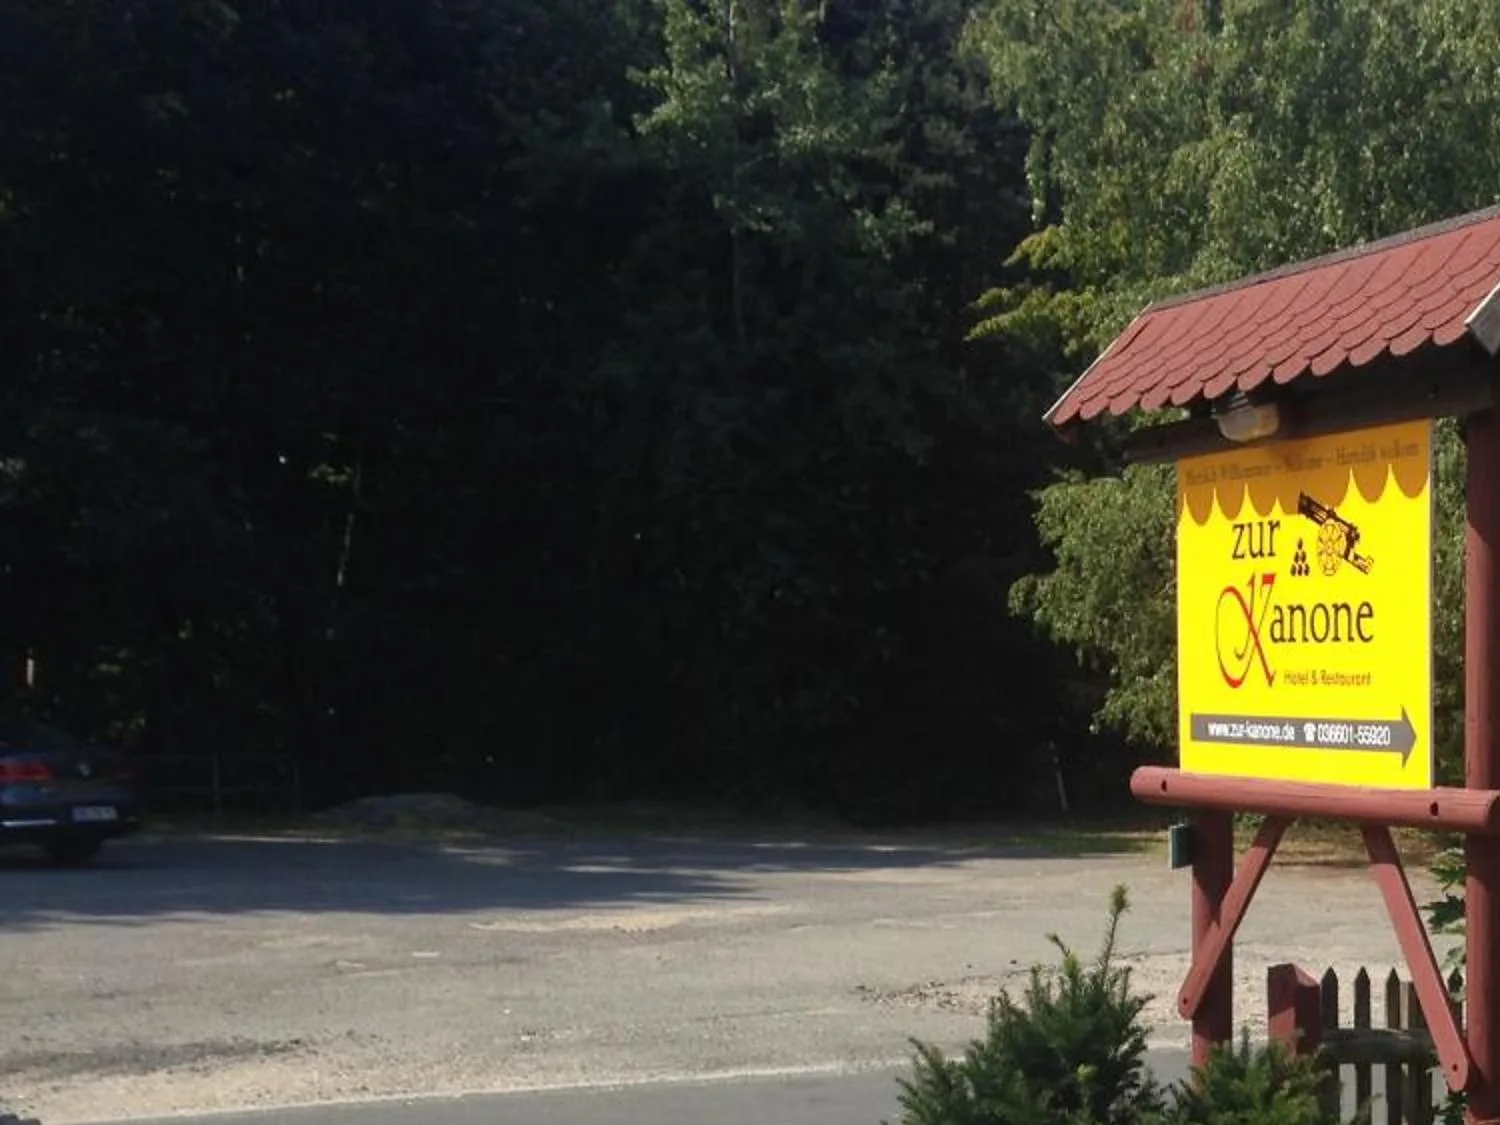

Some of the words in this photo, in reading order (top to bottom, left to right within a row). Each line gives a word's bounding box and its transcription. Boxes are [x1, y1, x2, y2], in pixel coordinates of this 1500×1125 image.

[1231, 519, 1281, 560] zur
[1215, 572, 1375, 688] Kanone
[1284, 670, 1308, 686] Hotel
[1320, 669, 1372, 687] Restaurant
